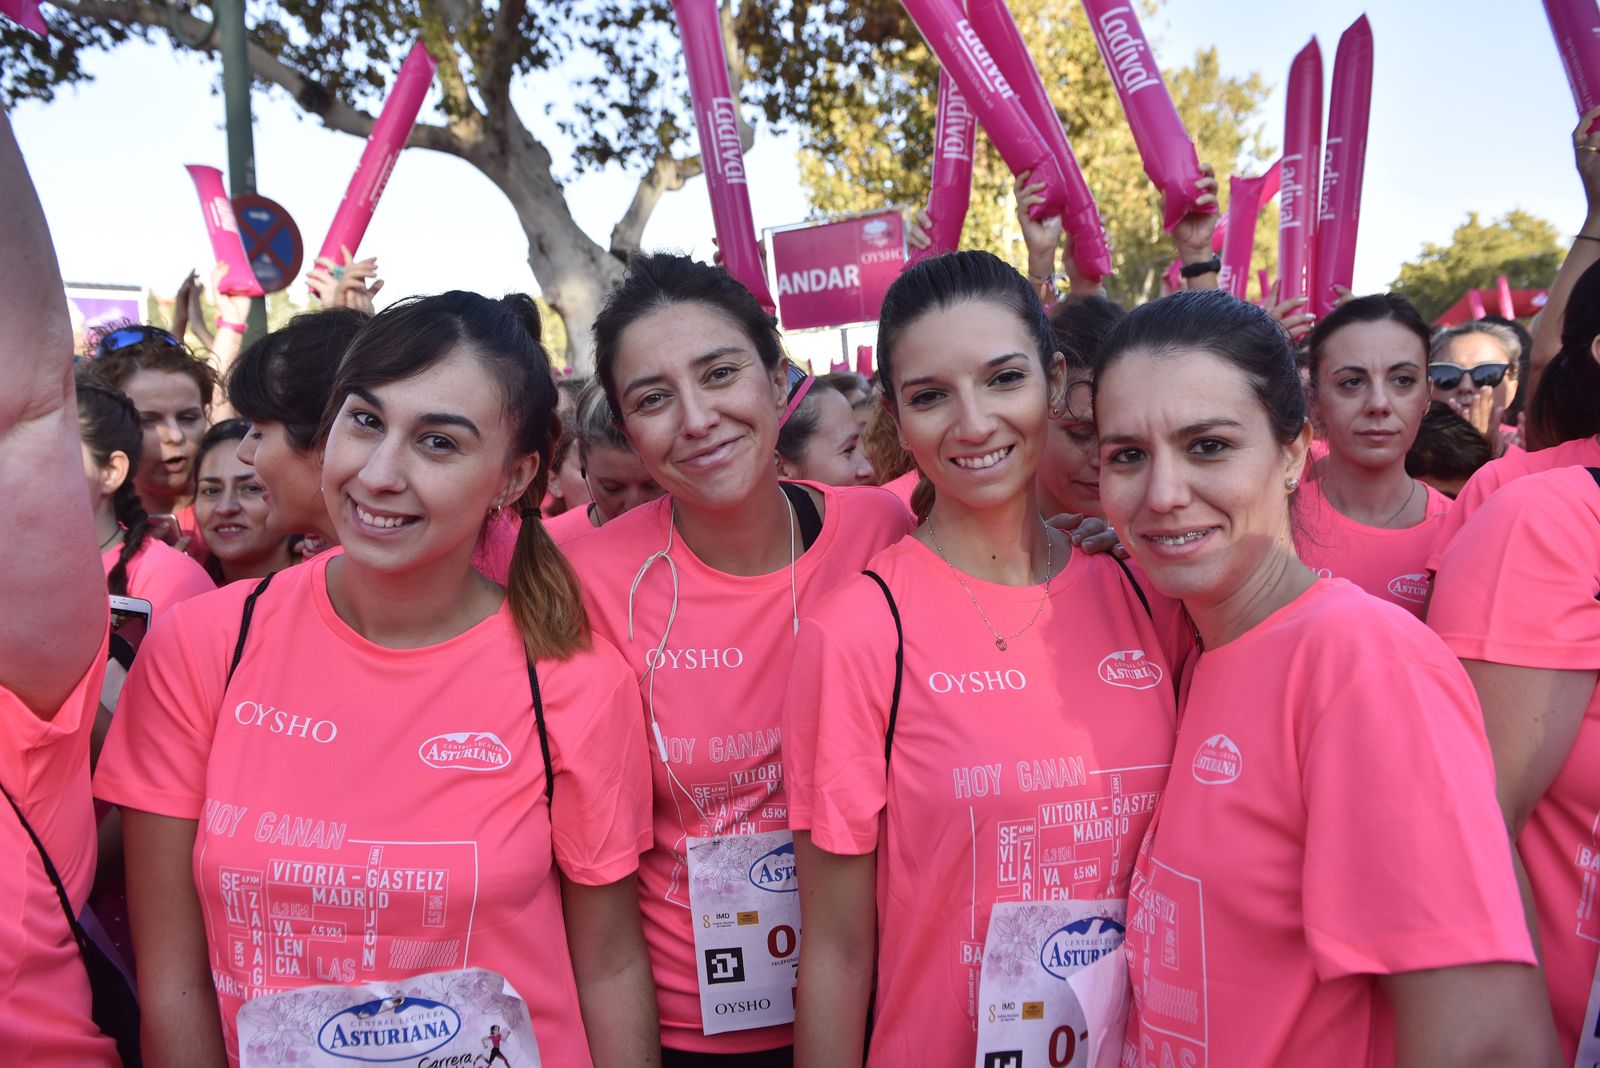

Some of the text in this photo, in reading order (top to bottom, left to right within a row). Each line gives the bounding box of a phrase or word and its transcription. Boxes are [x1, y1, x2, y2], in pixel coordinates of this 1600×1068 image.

[1098, 6, 1161, 95] Ladival
[941, 75, 972, 162] adival
[712, 97, 747, 185] Ladival
[1279, 153, 1303, 231] Ladival
[778, 264, 861, 296] ANDAR
[645, 647, 744, 670] OYSHO
[929, 669, 1026, 693] OYSHO
[234, 700, 338, 743] OYSHO
[425, 743, 504, 765] ASTURIANA
[708, 727, 781, 763] GANAN
[953, 755, 1087, 799] HOY GANAN
[694, 787, 711, 799] SE
[205, 799, 347, 850] HOY GANAN
[774, 808, 787, 818] KM
[1042, 800, 1098, 825] VITORIA
[1000, 826, 1018, 845] SE
[1073, 816, 1129, 843] MADRID
[221, 872, 241, 891] SE
[273, 861, 346, 886] VITORIA
[367, 869, 444, 891] GASTEIZ
[1085, 865, 1097, 879] KM
[312, 887, 390, 909] MADRID
[767, 924, 802, 959] 0
[275, 957, 301, 976] CIA
[1048, 942, 1117, 968] ASTUR
[316, 956, 357, 982] LAS
[350, 1010, 446, 1028] CENTRAL LECHERA
[715, 998, 771, 1016] OYSHO
[330, 1019, 452, 1050] ASTURIANA
[1048, 1024, 1089, 1068] 0
[418, 1052, 473, 1068] Carrera
